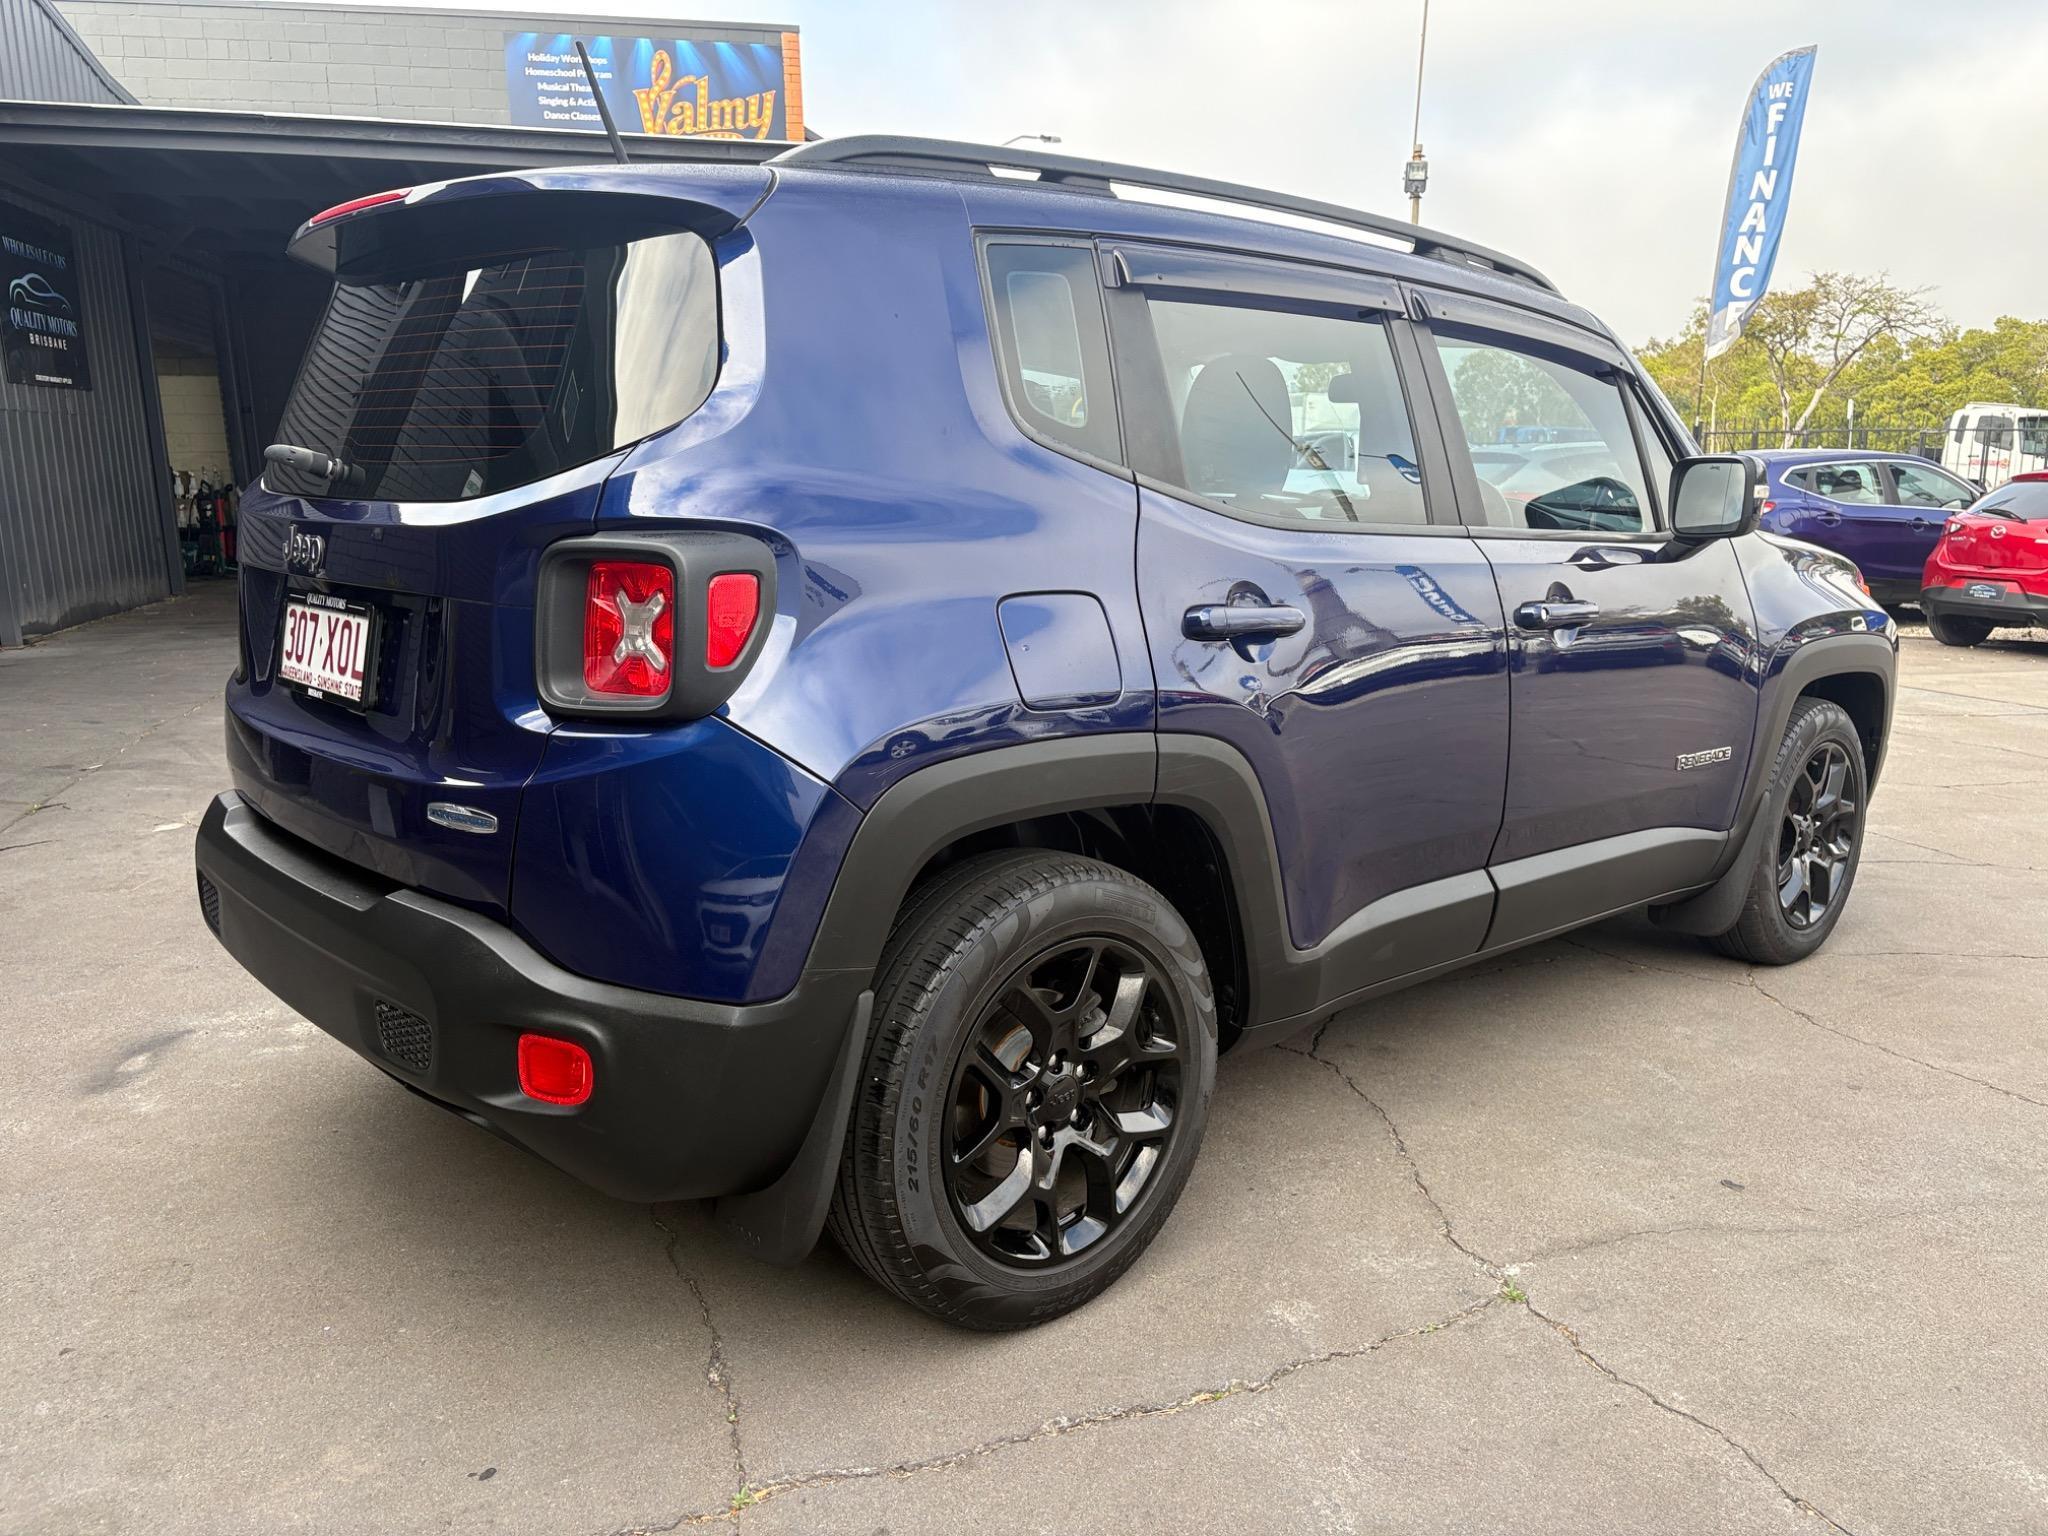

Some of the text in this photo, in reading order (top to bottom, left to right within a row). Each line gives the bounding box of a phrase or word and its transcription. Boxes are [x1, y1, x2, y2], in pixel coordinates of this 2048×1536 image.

[527, 53, 560, 63] Holiday
[525, 67, 576, 77] Homeschool
[537, 82, 570, 91] Musical
[1768, 81, 1794, 100] WE
[538, 96, 568, 107] Singing
[569, 97, 577, 106] &
[543, 111, 570, 120] Dance
[10, 307, 77, 337] QUALITY MOTORS
[29, 333, 67, 350] BRISBANE
[282, 524, 325, 573] Jeep
[285, 608, 364, 681] 307 XOL
[317, 674, 342, 694] SUNSHINE
[344, 681, 362, 699] STATE
[1677, 746, 1731, 770] RENEGADE
[906, 1096, 922, 1193] 215/60
